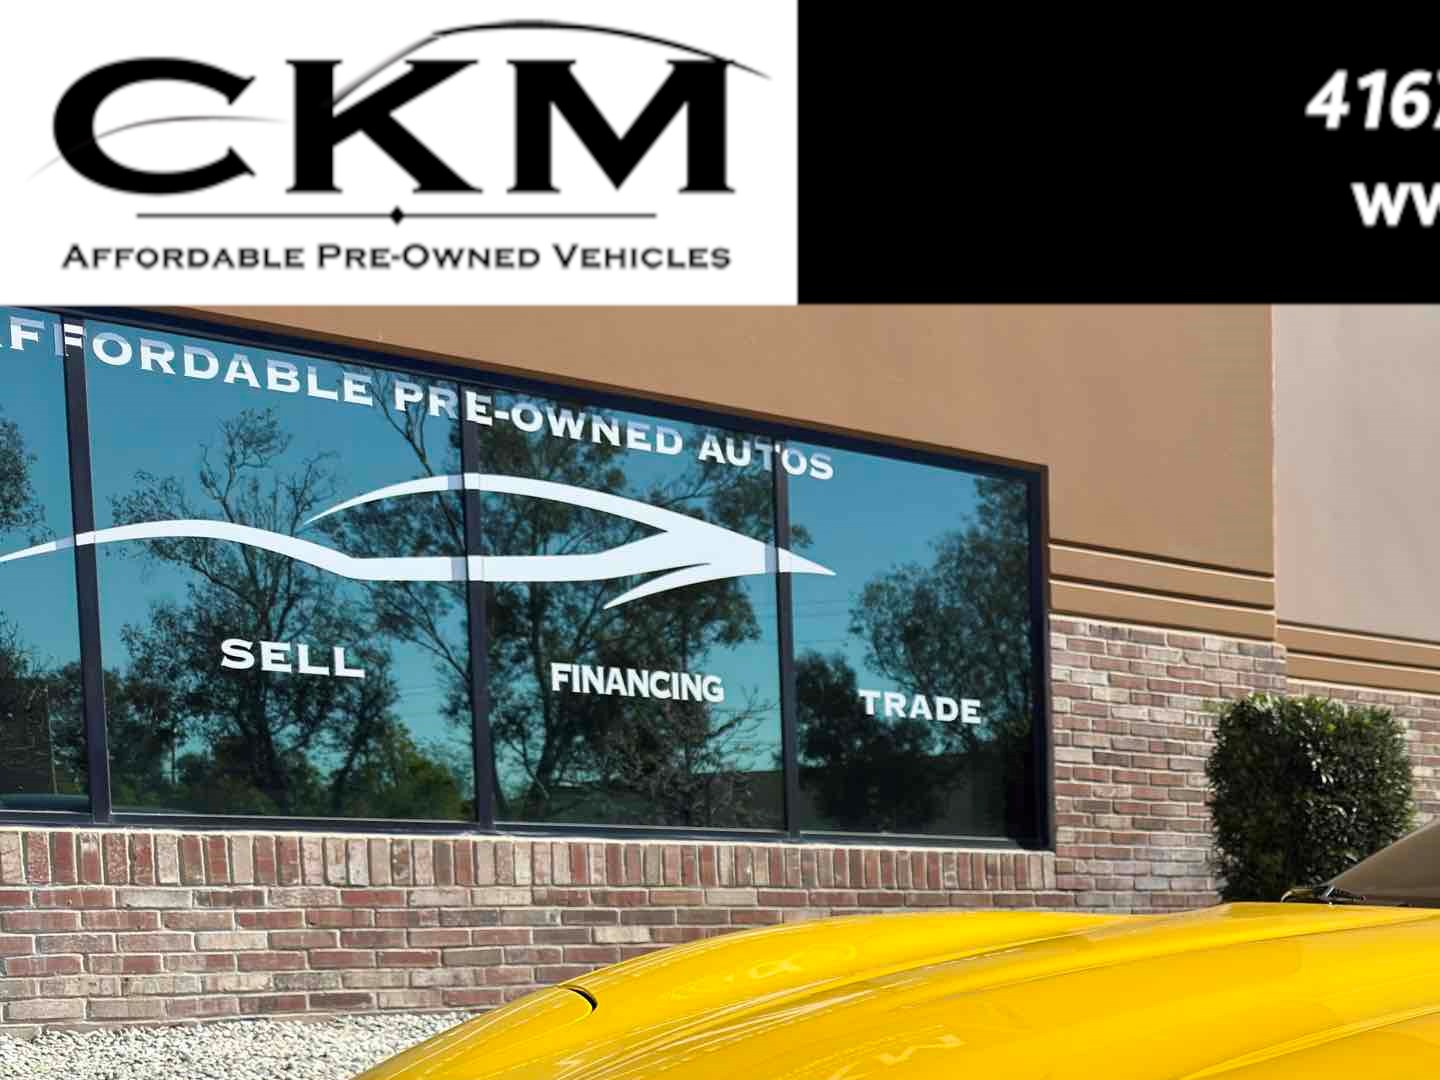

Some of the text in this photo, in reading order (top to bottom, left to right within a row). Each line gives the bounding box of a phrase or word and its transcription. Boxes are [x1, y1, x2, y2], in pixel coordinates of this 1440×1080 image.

[0, 315, 834, 481] FFORDABLE PRE-OWNED AUTOS
[220, 638, 366, 679] SELL
[550, 662, 725, 703] FINANCING
[858, 688, 982, 724] TRADE
